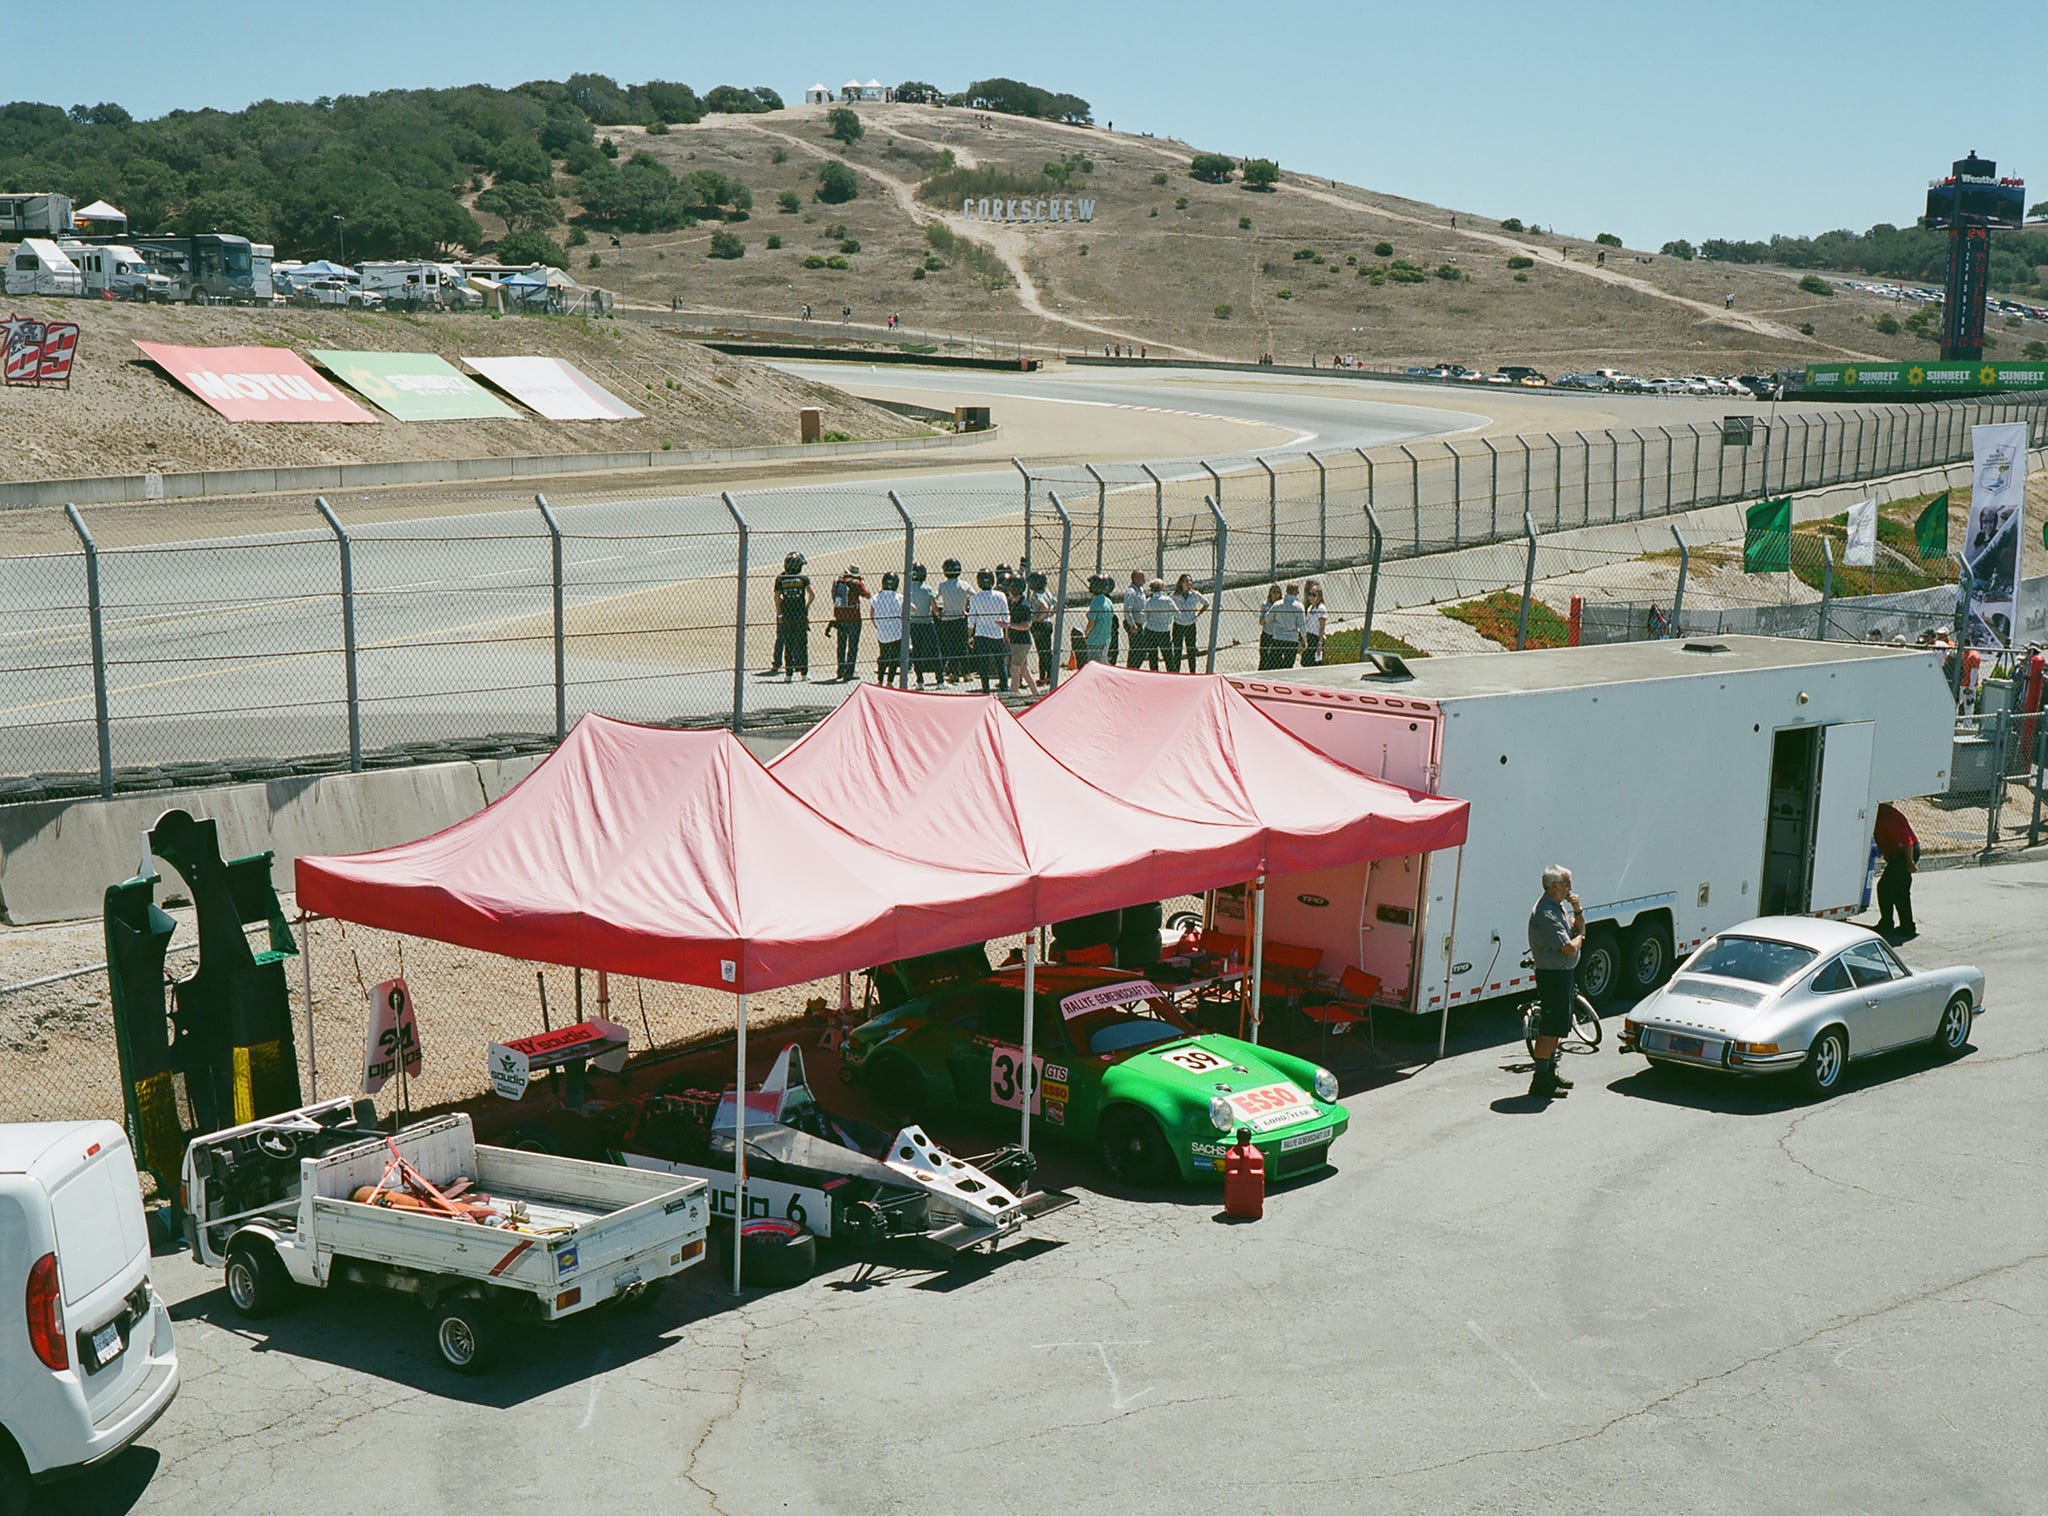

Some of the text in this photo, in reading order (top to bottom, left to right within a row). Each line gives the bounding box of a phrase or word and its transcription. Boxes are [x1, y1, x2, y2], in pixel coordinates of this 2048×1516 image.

[963, 198, 1096, 220] CORKSCREW
[5, 320, 80, 380] 69
[1858, 371, 1899, 381] SUNBELT
[1926, 370, 1971, 380] SUNBELT
[1998, 371, 2045, 380] SUNBELT
[185, 371, 335, 402] MOTUL
[1063, 997, 1096, 1014] RALLYE
[1095, 985, 1144, 1005] GEMEINSCHAFT
[537, 1030, 592, 1050] saudia
[1173, 1052, 1219, 1070] 39
[491, 1070, 525, 1086] saudia
[1046, 1065, 1067, 1080] GTS
[1043, 1083, 1067, 1099] ESSO
[1231, 1087, 1298, 1114] ESSO
[1191, 1142, 1226, 1156] SACHS
[786, 1192, 807, 1224] 6
